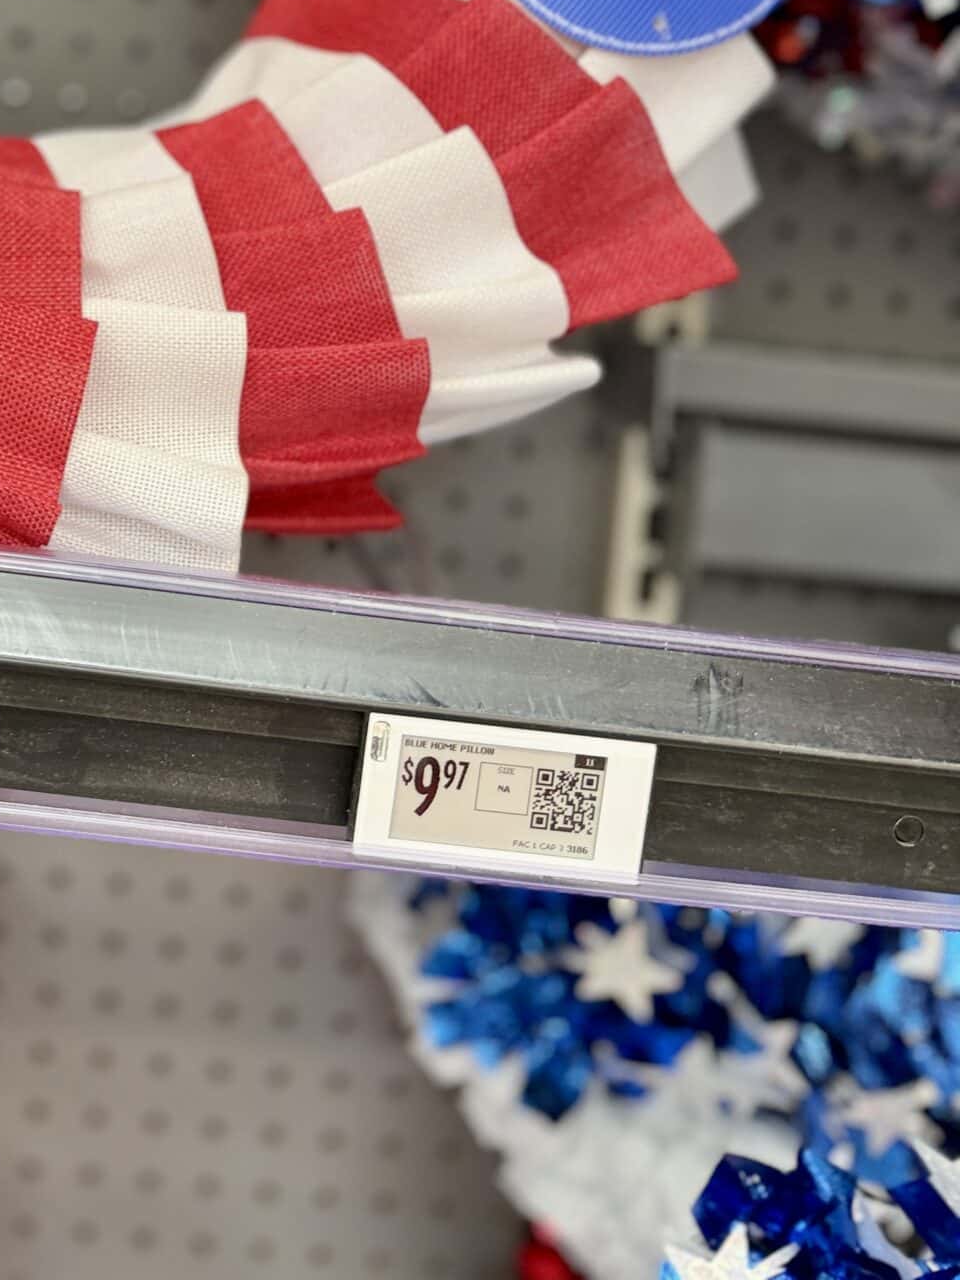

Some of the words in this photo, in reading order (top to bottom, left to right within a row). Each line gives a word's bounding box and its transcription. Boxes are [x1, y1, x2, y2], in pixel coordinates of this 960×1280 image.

[405, 738, 428, 750] BLUE
[430, 741, 457, 753] HOME
[460, 744, 496, 756] PILLOW
[497, 784, 511, 794] NA
